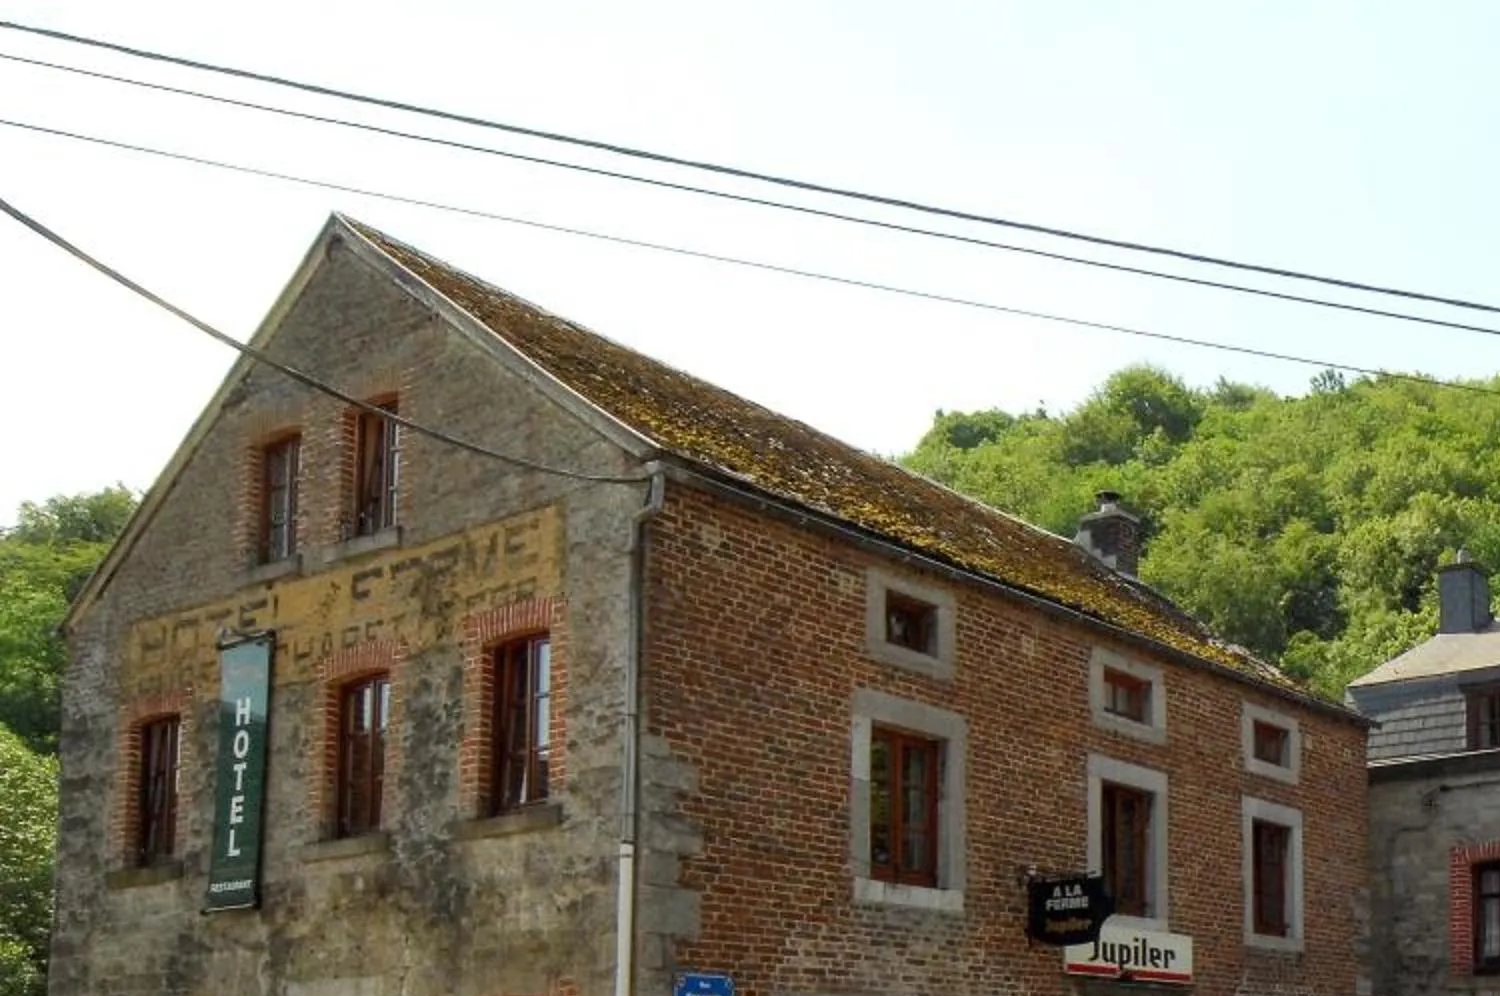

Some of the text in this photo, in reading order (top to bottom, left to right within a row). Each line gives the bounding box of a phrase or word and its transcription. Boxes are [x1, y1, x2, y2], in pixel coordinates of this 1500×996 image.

[227, 696, 251, 857] HOTEL
[1053, 884, 1083, 897] A LA
[1045, 896, 1089, 911] FERME
[1088, 937, 1177, 970] Jupiler
